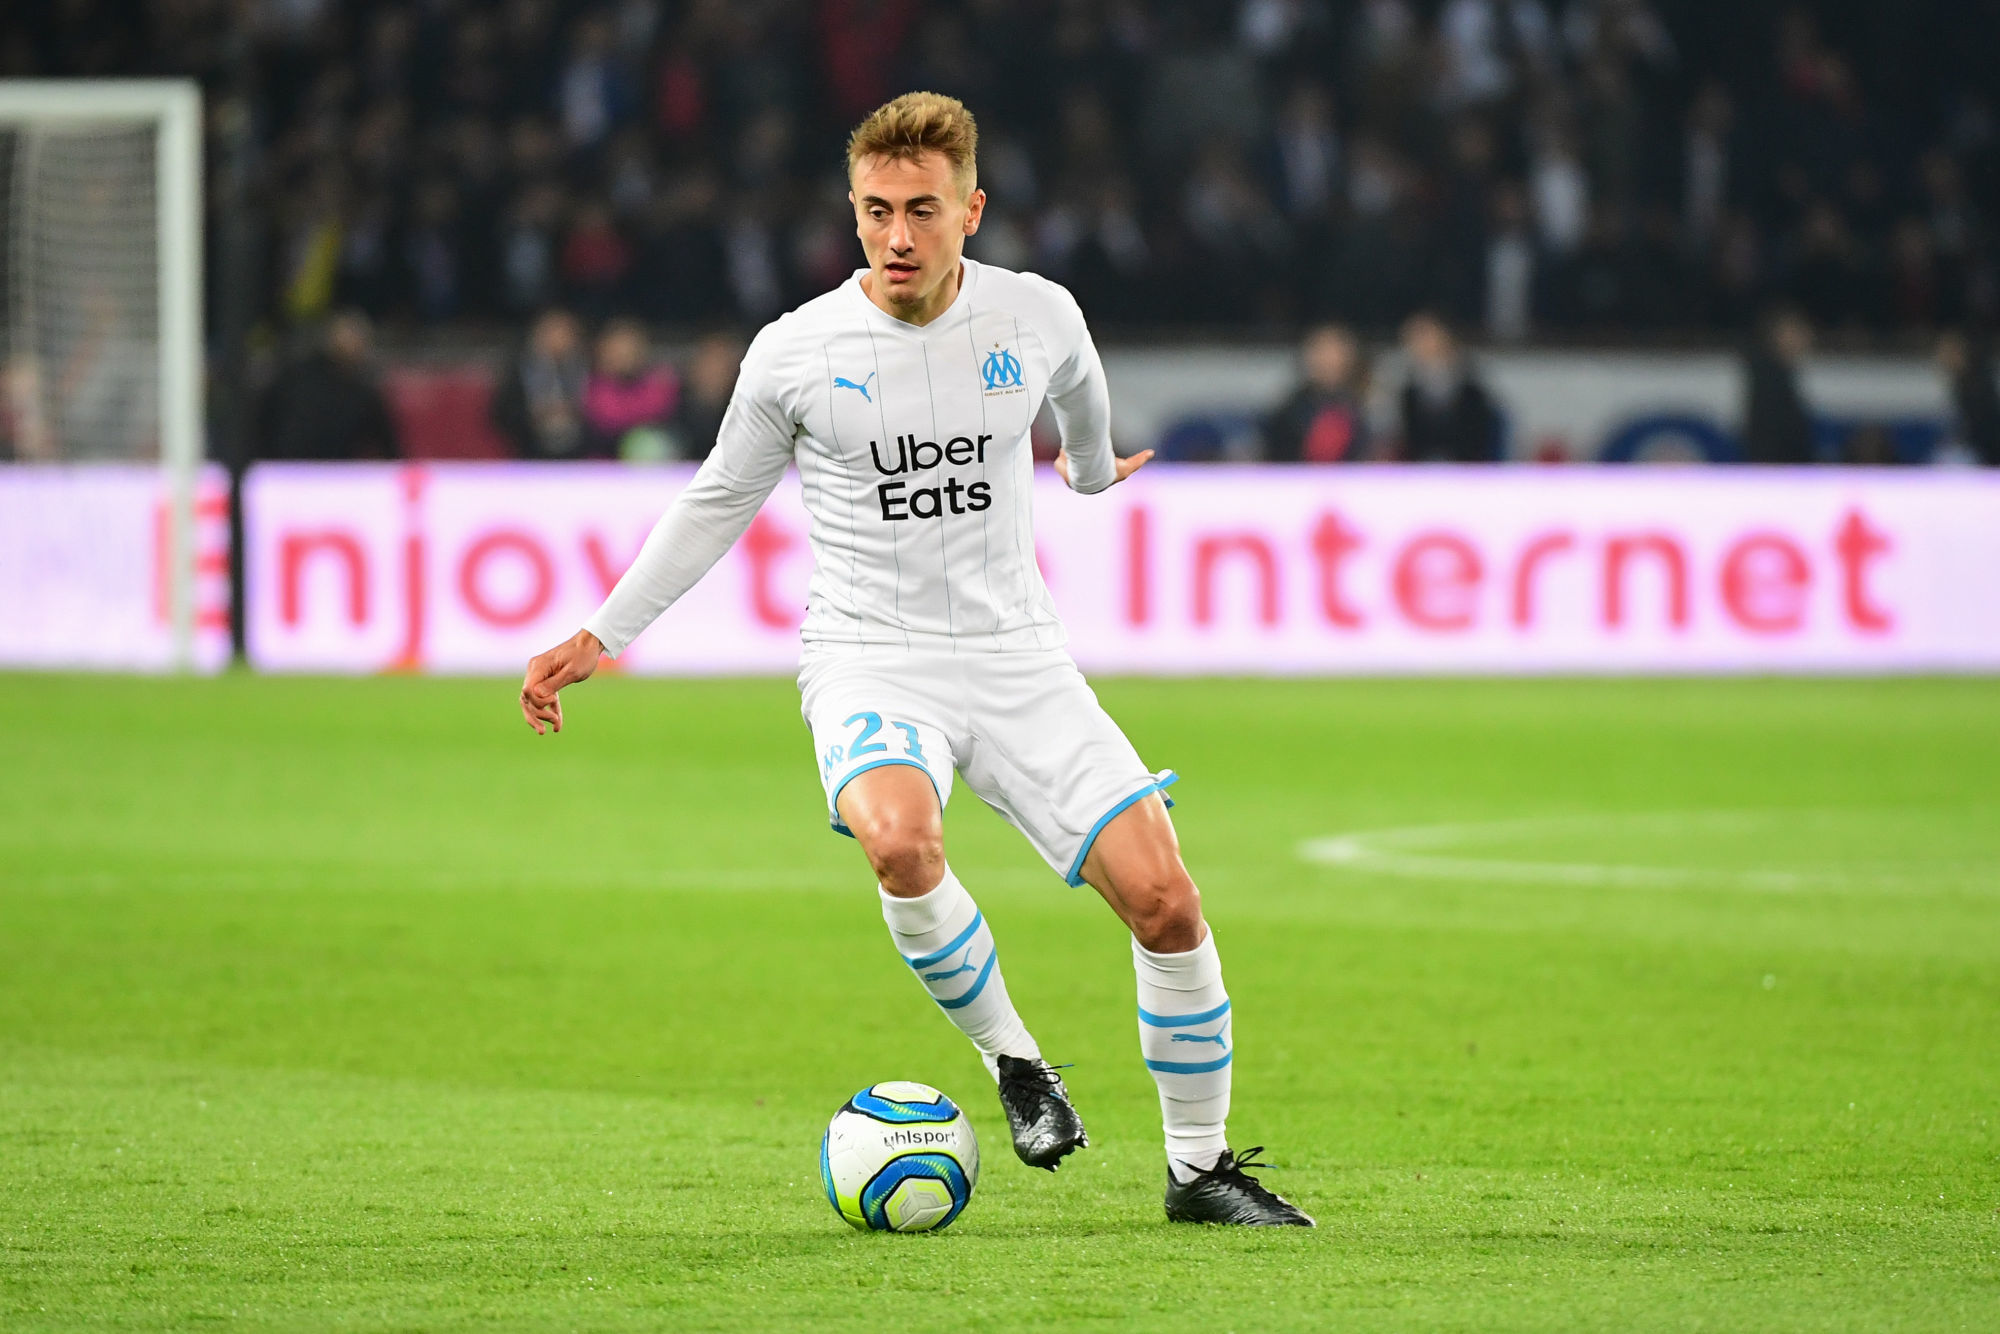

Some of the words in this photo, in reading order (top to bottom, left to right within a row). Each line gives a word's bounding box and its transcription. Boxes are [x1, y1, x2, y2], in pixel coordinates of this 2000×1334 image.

[870, 434, 992, 475] Uber
[878, 477, 992, 521] Eats
[1128, 507, 1891, 632] Internet
[842, 711, 928, 766] 21
[883, 1130, 957, 1150] uhlsport
